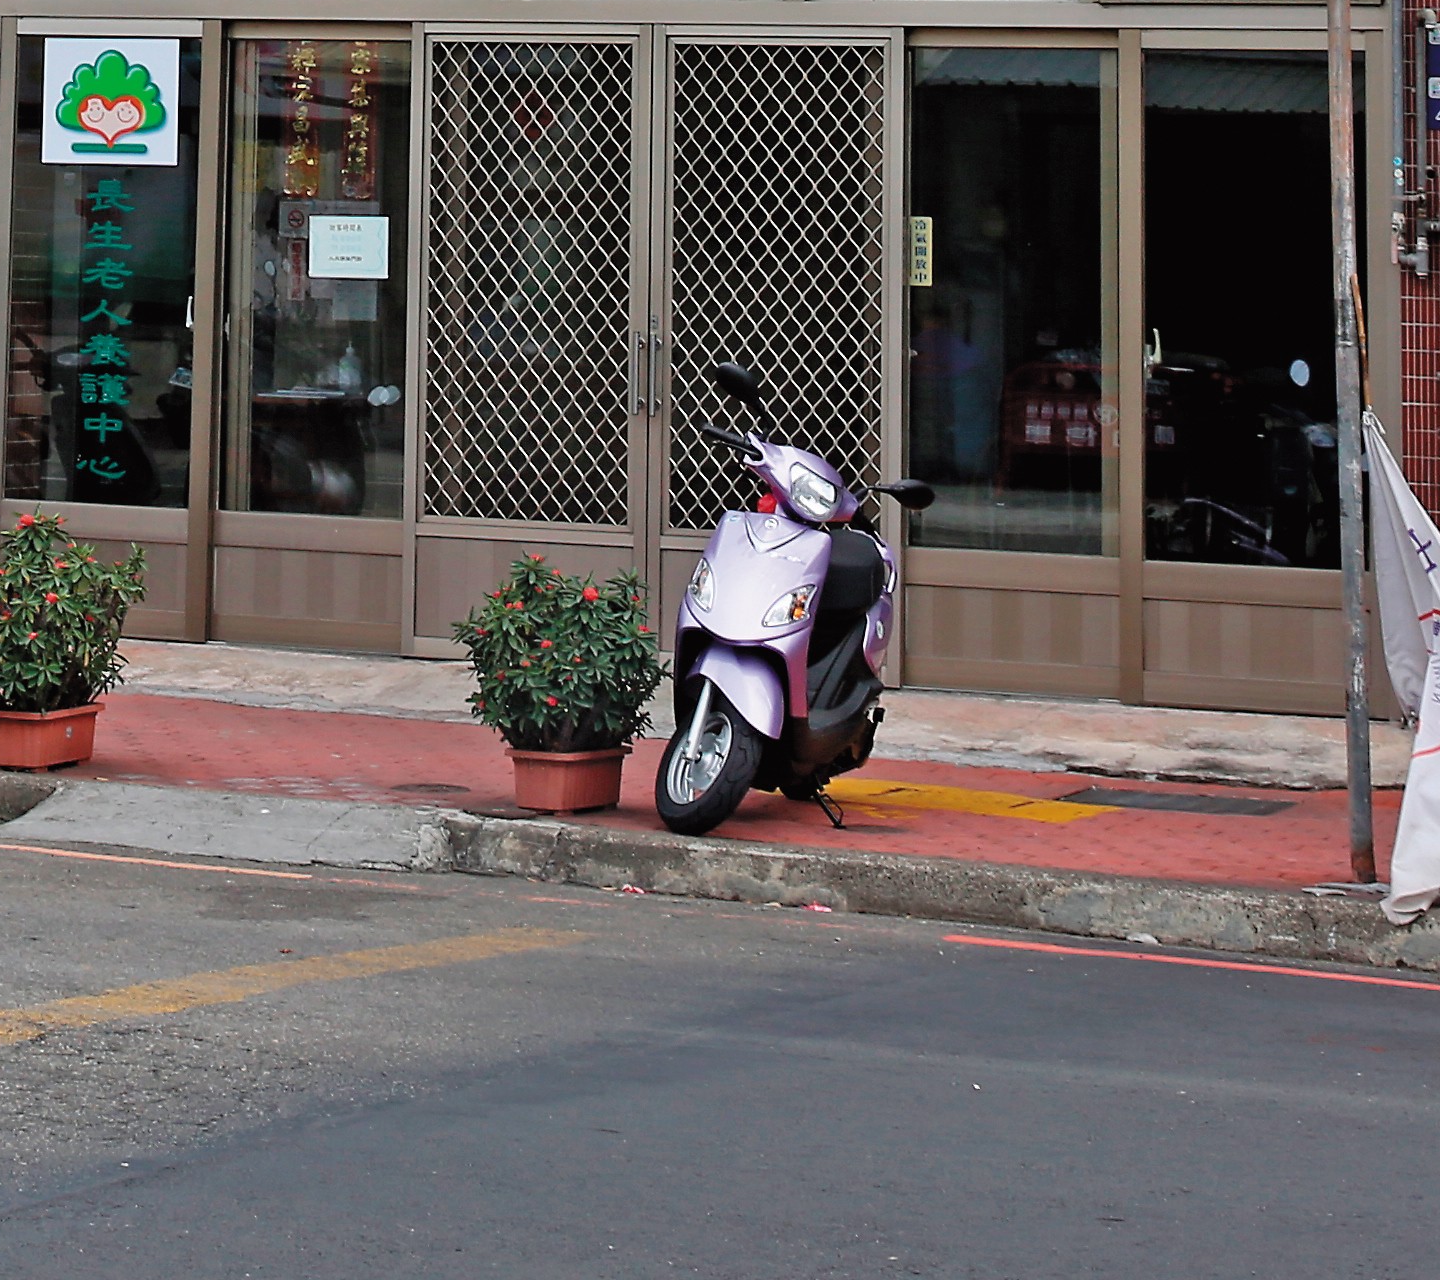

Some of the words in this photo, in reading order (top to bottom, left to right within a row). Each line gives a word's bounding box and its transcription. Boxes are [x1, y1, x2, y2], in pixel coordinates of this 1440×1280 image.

[76, 178, 135, 480] 長生老人養護中心
